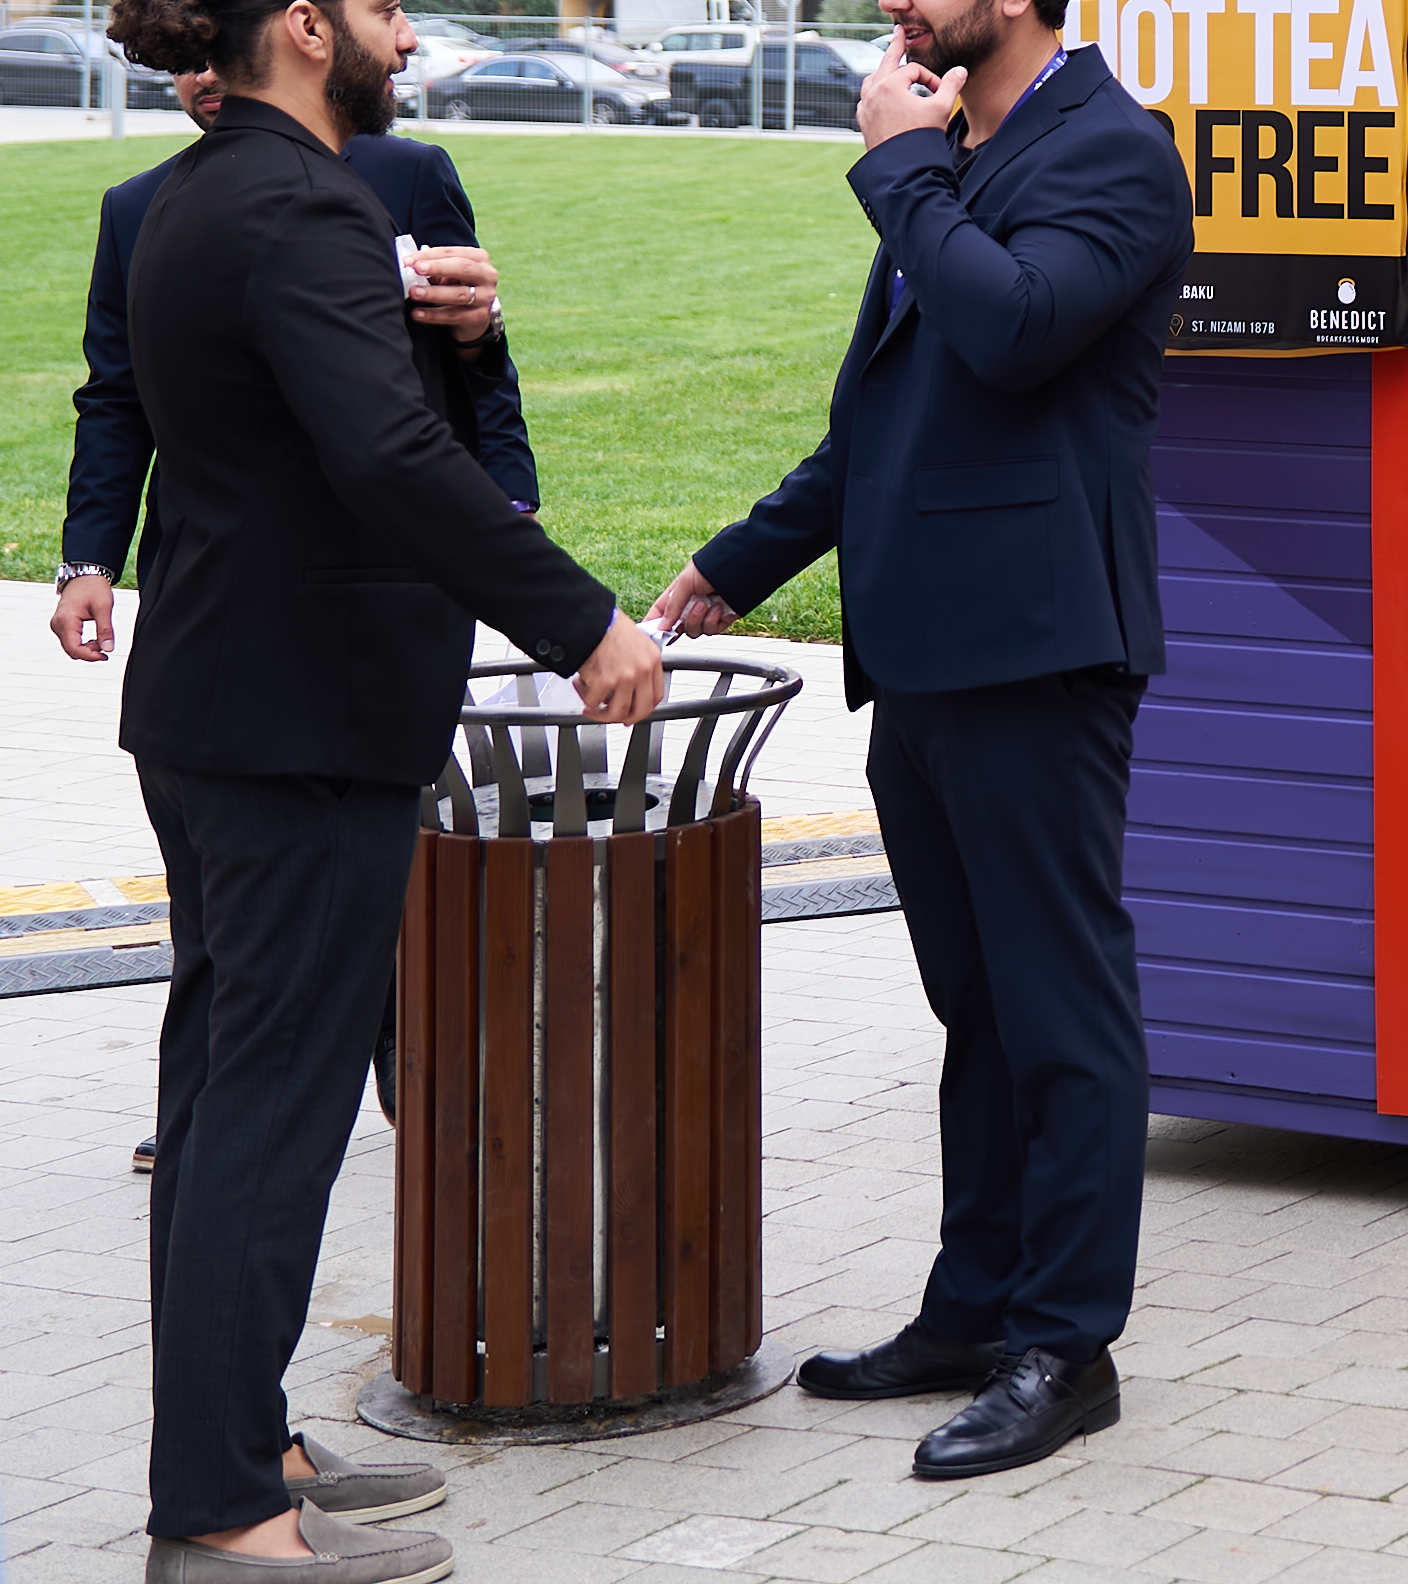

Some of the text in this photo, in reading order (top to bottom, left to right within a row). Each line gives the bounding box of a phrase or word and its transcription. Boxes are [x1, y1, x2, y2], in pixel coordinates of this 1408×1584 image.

[1194, 109, 1396, 221] FREE
[1179, 285, 1214, 301] .BAKU
[1191, 320, 1275, 335] ST. NIZAMI 187B
[1309, 309, 1387, 331] BENEDICT
[1316, 335, 1379, 344] BREAKFAST&MORE
